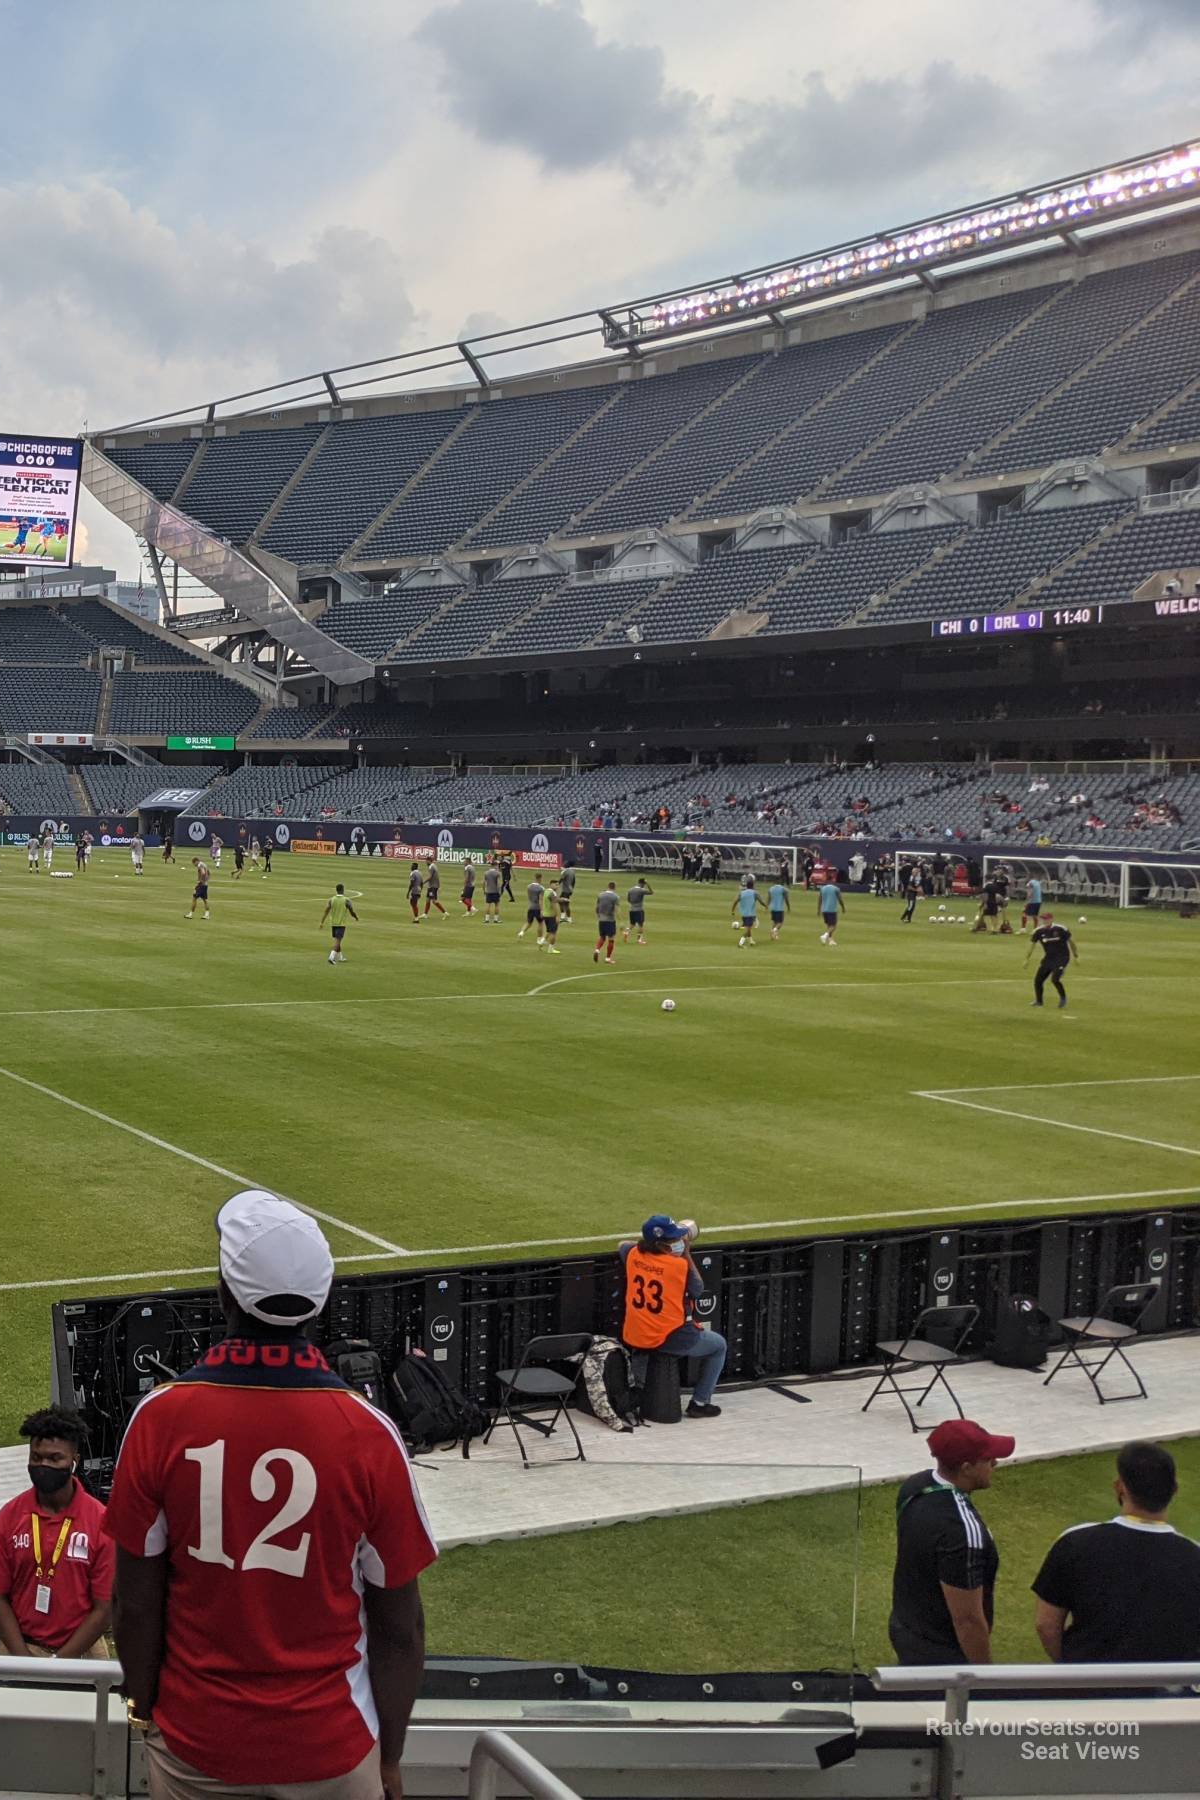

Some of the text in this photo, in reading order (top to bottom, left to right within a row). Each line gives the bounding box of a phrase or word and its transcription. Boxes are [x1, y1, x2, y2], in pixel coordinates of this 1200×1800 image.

[0, 442, 73, 456] @CHICAGOFIRE
[24, 478, 71, 487] TICKET
[32, 486, 69, 495] PLAN
[1155, 598, 1200, 616] WELC
[940, 609, 1091, 635] CHI 0 ORL 0 11:40
[394, 846, 434, 857] PIZZA PUFF
[437, 847, 484, 864] Heineken
[522, 852, 558, 863] BODYARMOR
[937, 1275, 949, 1284] TGI
[632, 1274, 664, 1314] 33
[699, 1299, 712, 1307] TGI
[435, 1324, 448, 1333] TGI
[184, 1439, 317, 1578] 12
[12, 1533, 30, 1549] 340
